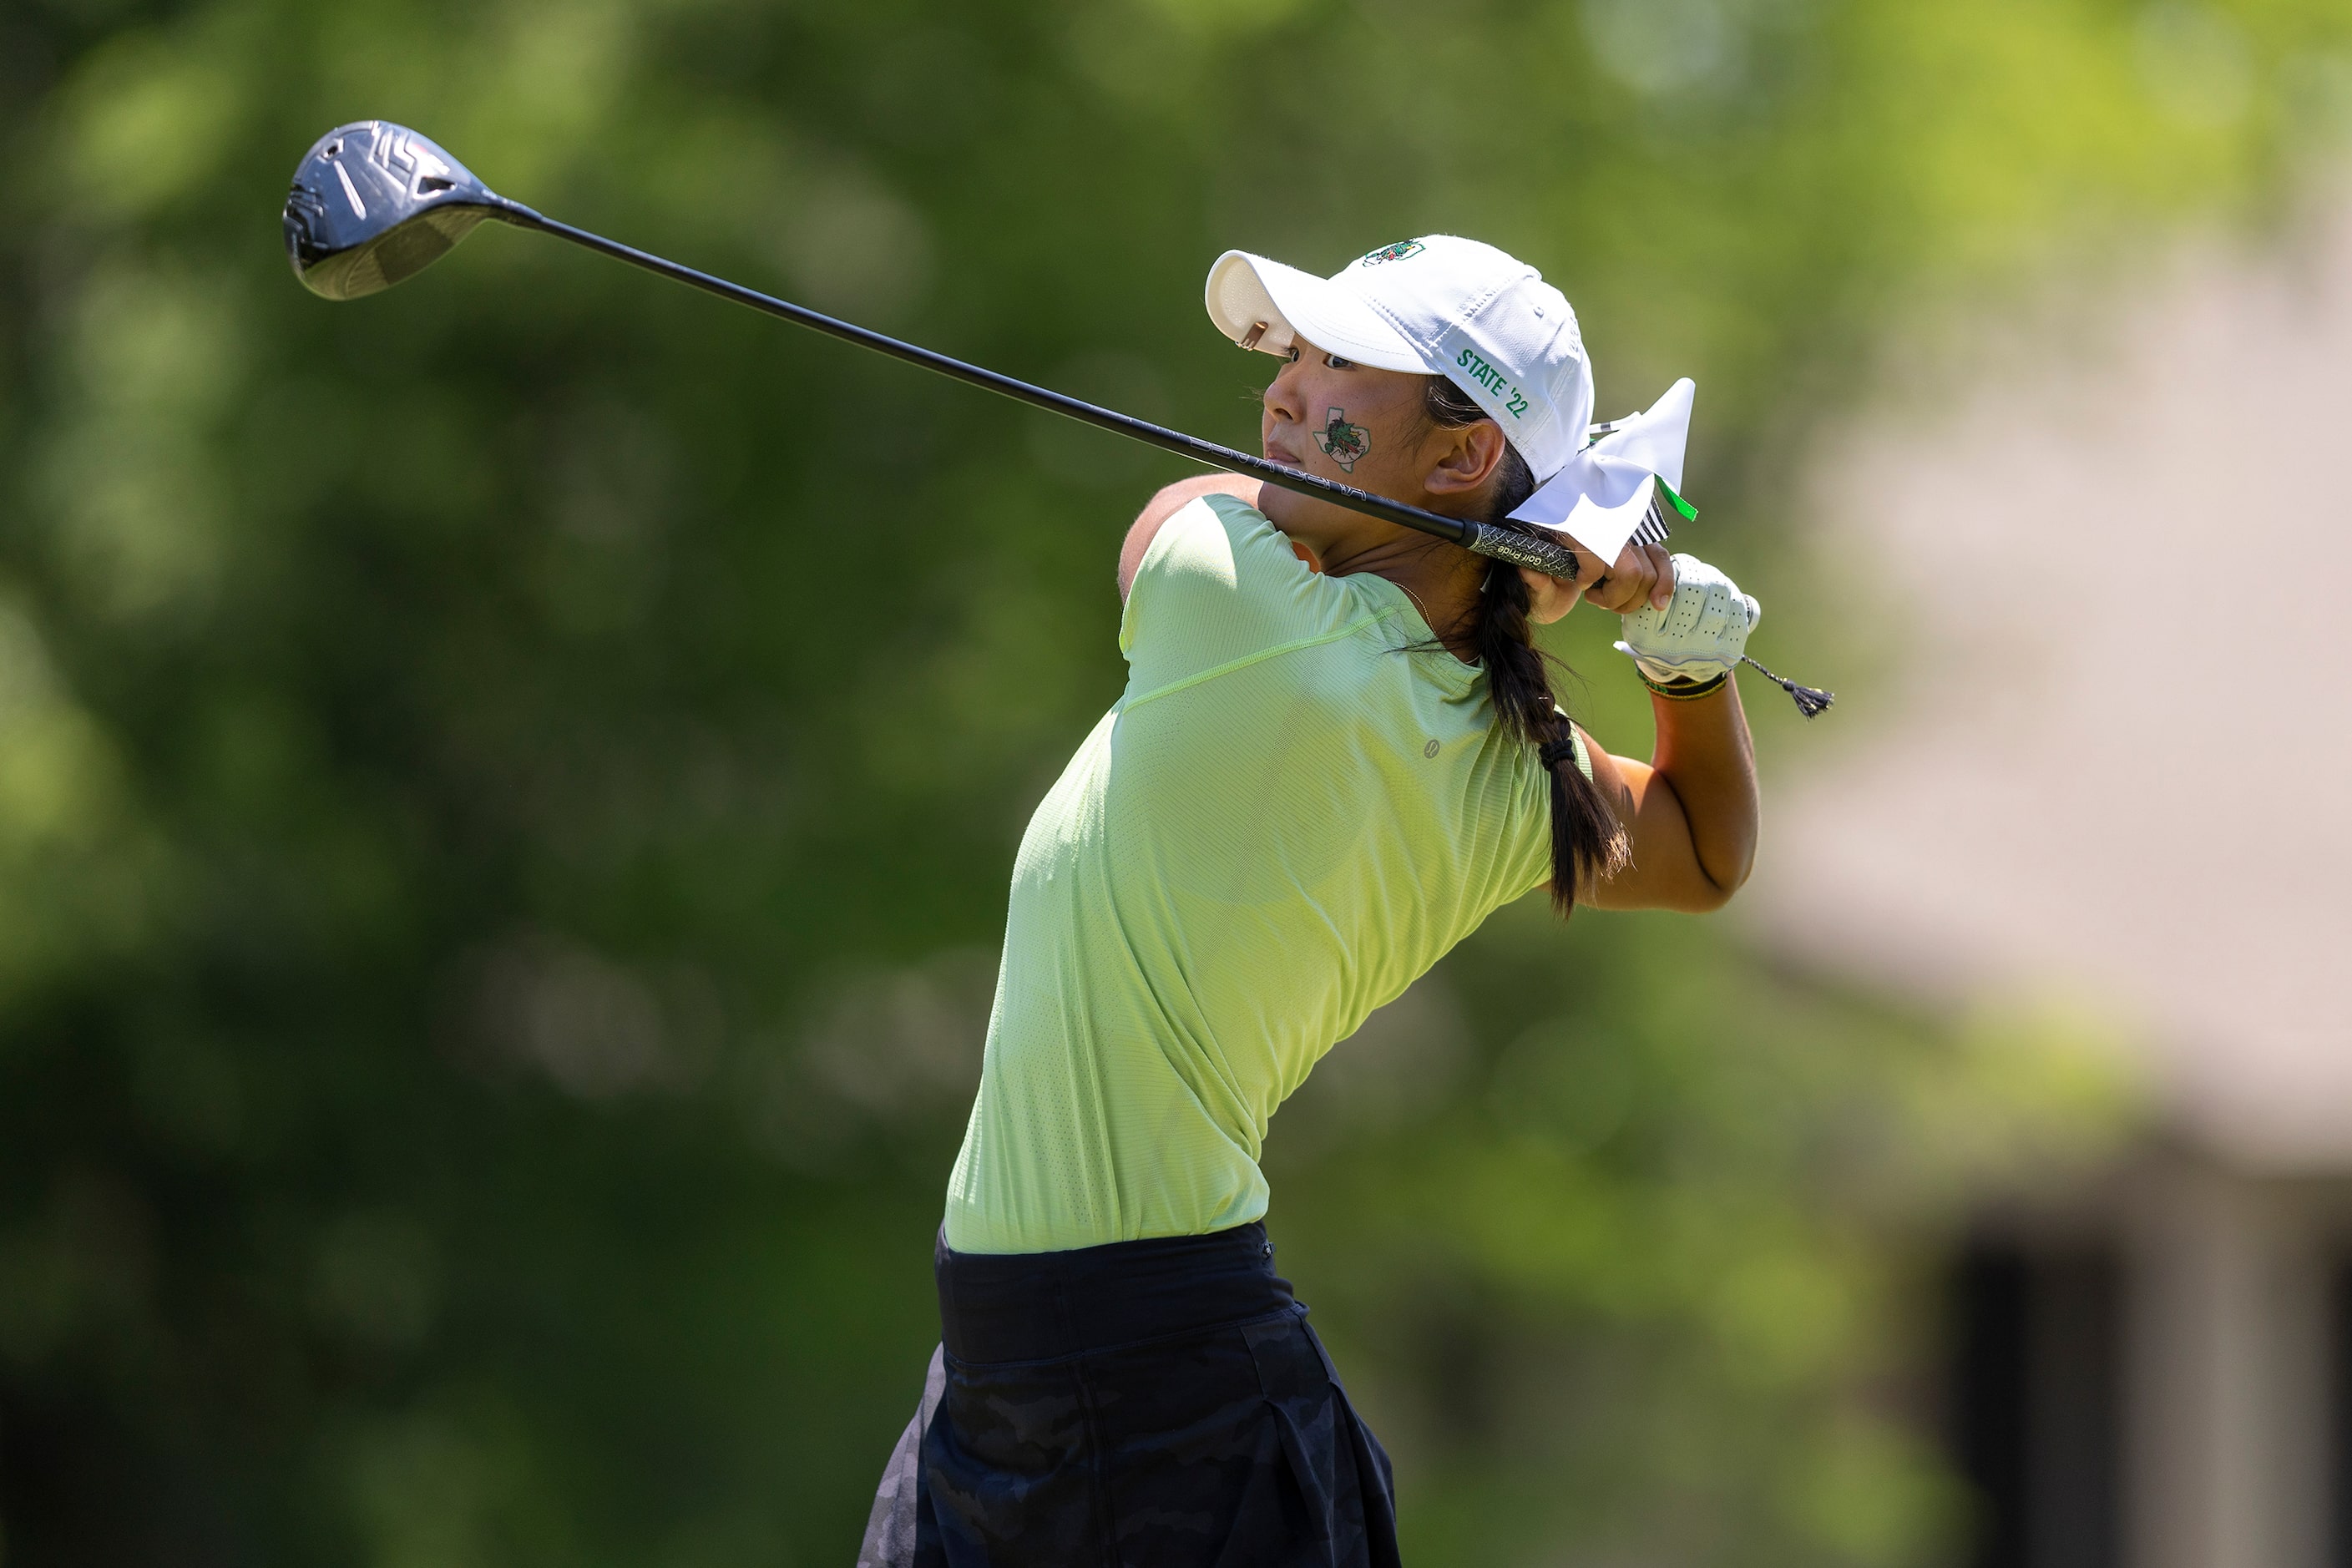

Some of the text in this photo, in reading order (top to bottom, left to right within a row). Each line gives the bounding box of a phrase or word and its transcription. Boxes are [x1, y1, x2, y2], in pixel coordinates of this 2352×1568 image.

[1457, 349, 1529, 418] STATE '22
[1497, 545, 1542, 566] Golf Pride
